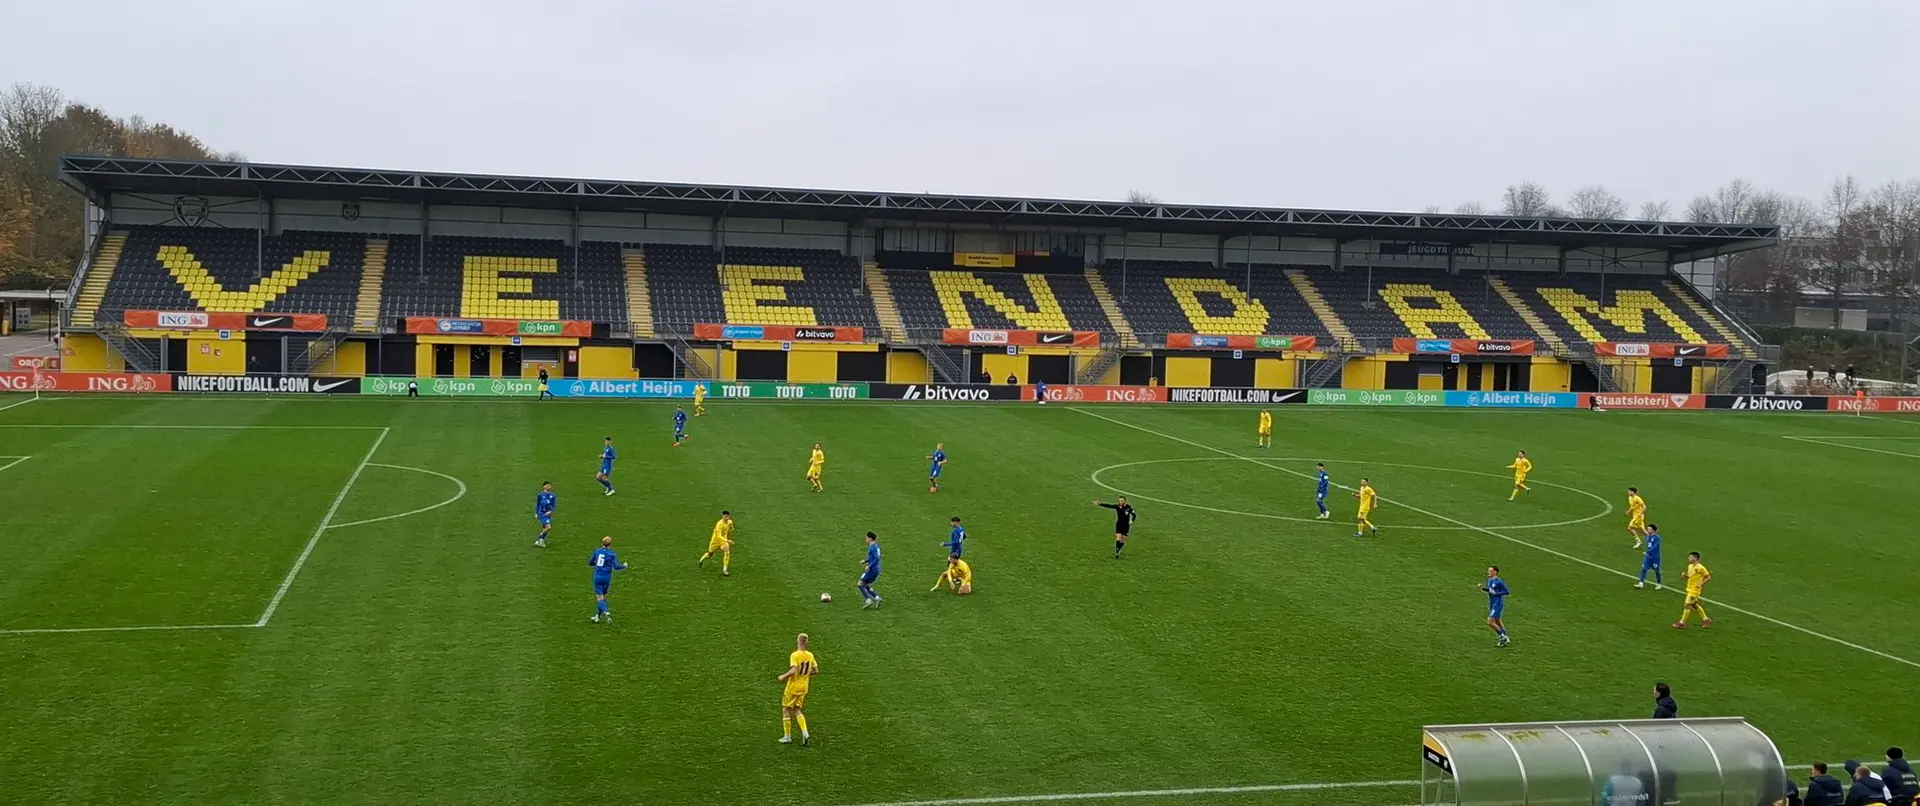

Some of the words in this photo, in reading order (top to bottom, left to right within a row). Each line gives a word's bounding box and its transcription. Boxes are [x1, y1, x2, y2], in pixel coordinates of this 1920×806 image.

[1408, 245, 1475, 255] JEUGDTRUN
[161, 315, 187, 325] ING
[537, 323, 555, 332] kpn
[805, 329, 835, 338] bitvavo
[971, 332, 991, 342] ING
[1270, 339, 1286, 347] kpn
[1486, 343, 1511, 351] bitvavo
[1617, 344, 1635, 354] ING
[0, 376, 27, 389] NG
[88, 377, 134, 390] ING
[178, 376, 308, 391] NIKEFOOTBALL.COM
[389, 380, 408, 391] kp
[450, 381, 475, 392] kpn
[507, 382, 532, 393] kpn
[589, 381, 637, 393] Albert
[643, 382, 683, 396] Heijn
[722, 385, 750, 397] TOTO
[776, 386, 803, 398] TOTO
[829, 387, 856, 398] TOTO
[925, 385, 989, 400] bitvavo
[1106, 390, 1135, 401] ING
[1172, 389, 1269, 402] NIKEFOOTBALL.COM
[1326, 391, 1346, 402] kpn
[1372, 392, 1392, 403] kpn
[1417, 393, 1437, 403] kpn
[1482, 392, 1520, 404] Albert
[1524, 393, 1556, 407] Heijn
[1596, 396, 1669, 408] Staatsloterij
[1750, 396, 1802, 410] bitvavo
[1838, 400, 1862, 411] ING
[597, 554, 605, 567] 6
[800, 661, 810, 675] 11
